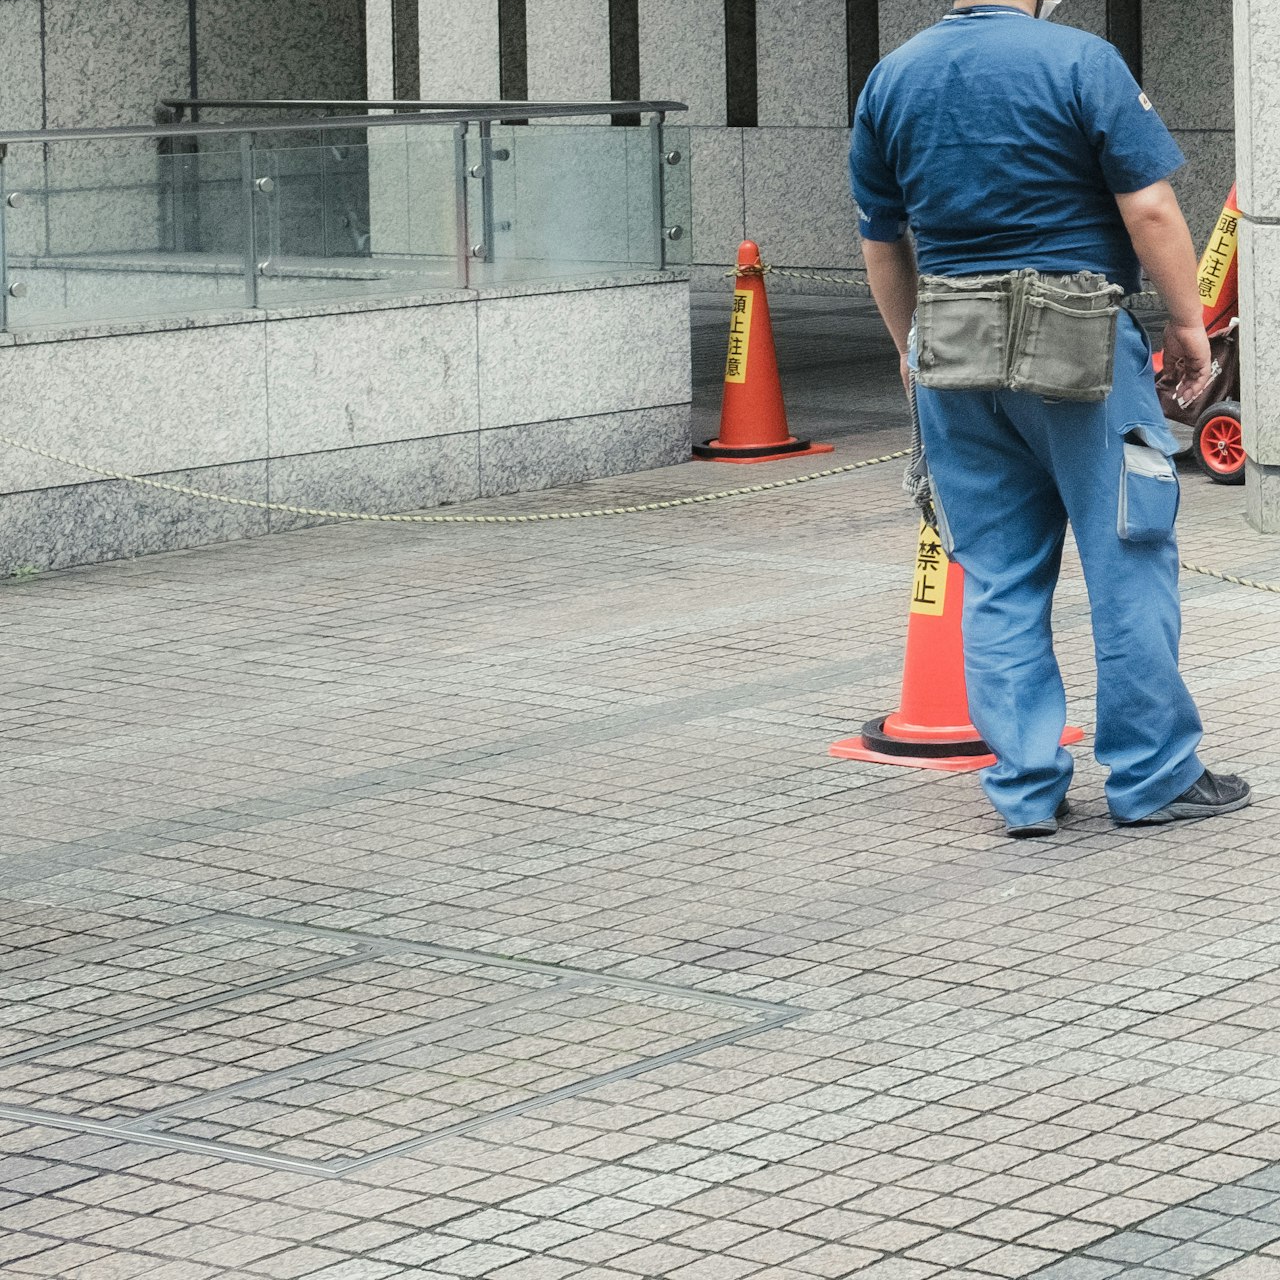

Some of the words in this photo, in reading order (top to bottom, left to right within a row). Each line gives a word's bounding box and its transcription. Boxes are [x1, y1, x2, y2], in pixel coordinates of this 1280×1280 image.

[1199, 213, 1237, 299] 頭上注意
[727, 295, 747, 376] 頭上注意
